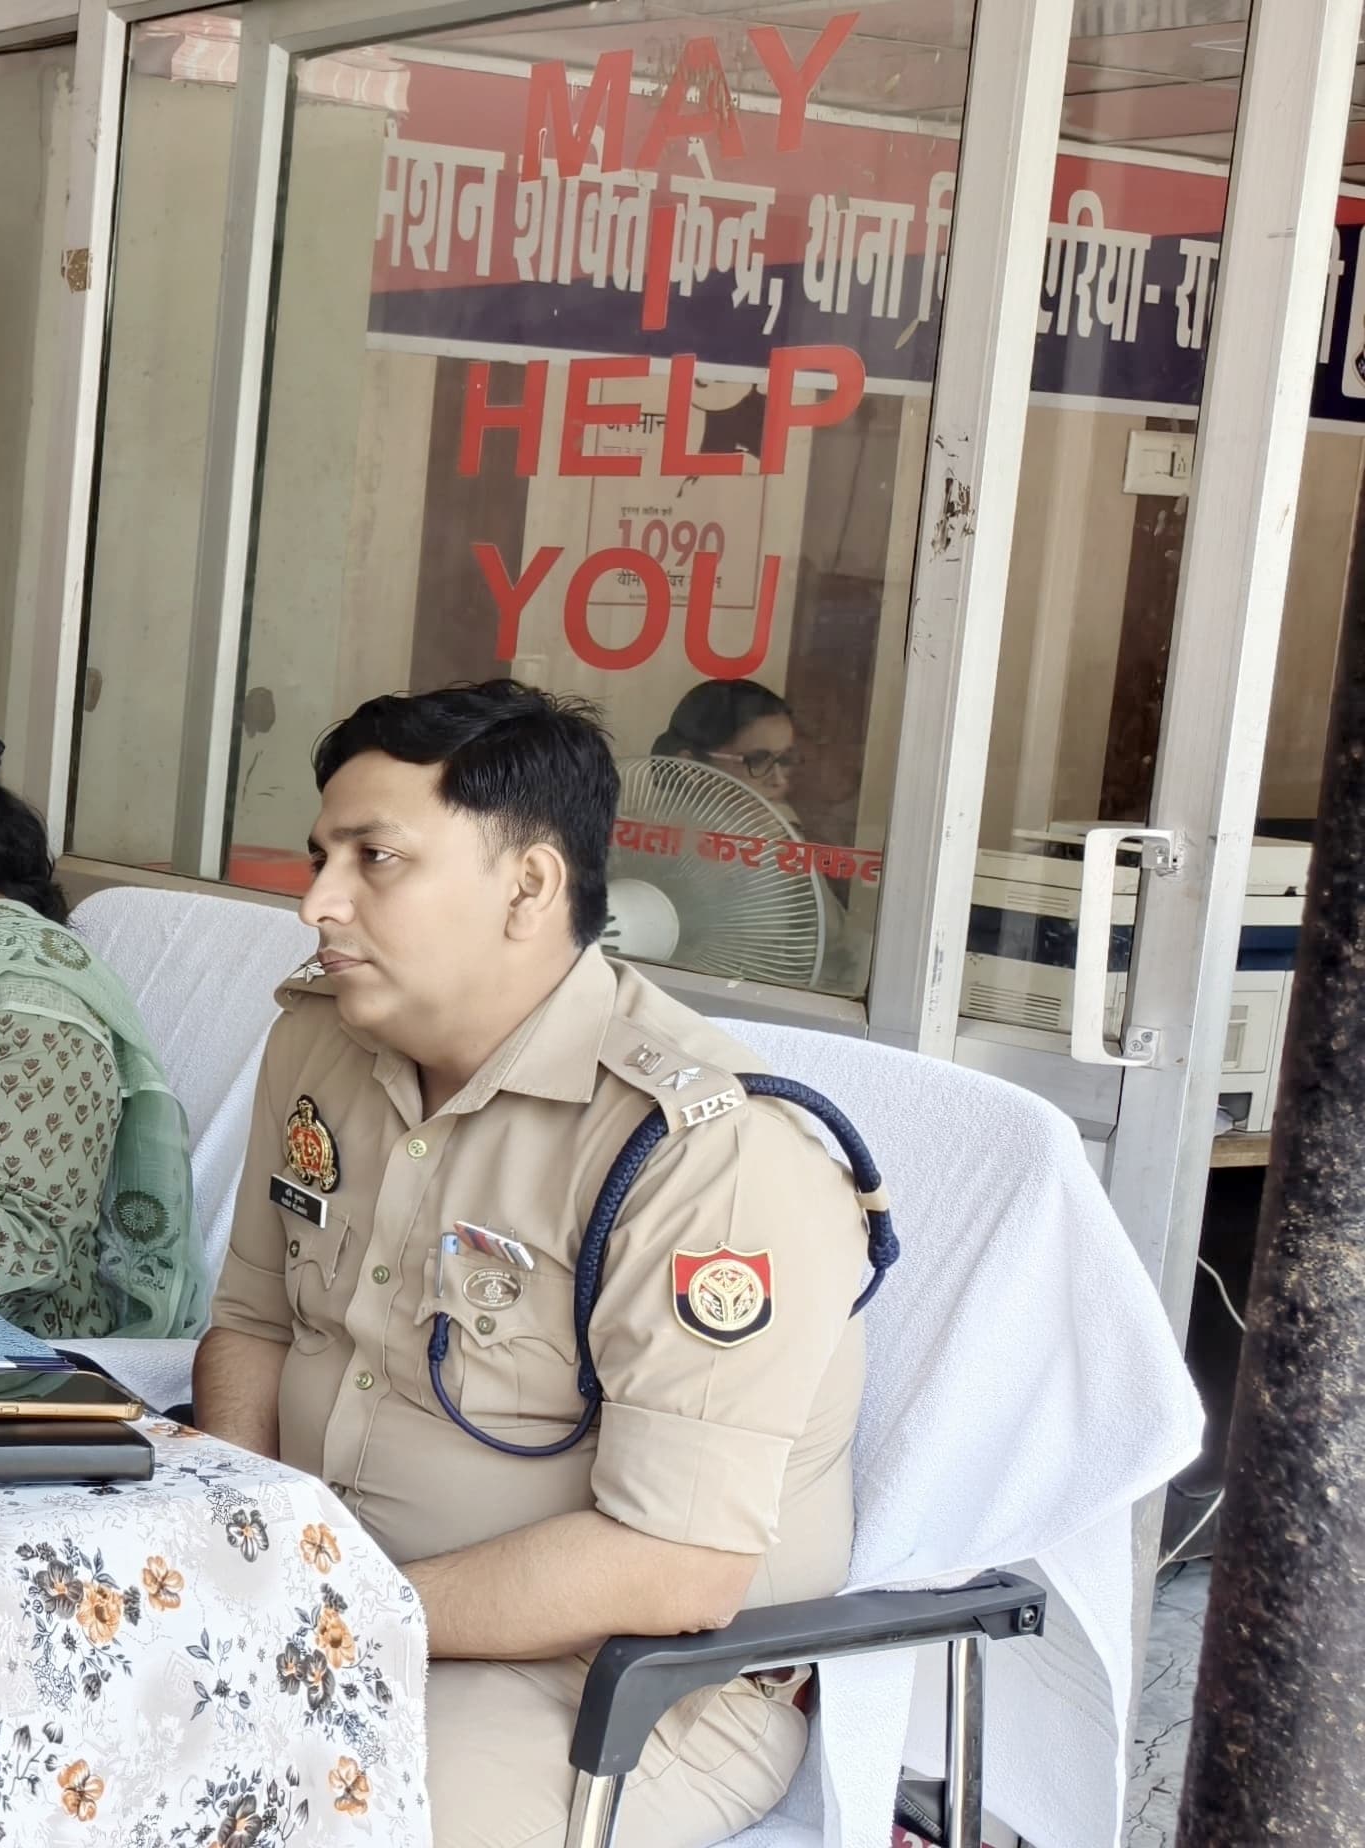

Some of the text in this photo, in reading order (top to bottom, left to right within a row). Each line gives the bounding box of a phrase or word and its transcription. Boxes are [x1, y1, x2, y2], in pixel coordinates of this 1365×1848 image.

[520, 12, 860, 182] MAY
[642, 205, 677, 331] I
[803, 194, 914, 318] थाना
[457, 345, 866, 476] HELP
[618, 519, 726, 567] 1090
[472, 543, 782, 681] YOU
[695, 830, 768, 868] कर
[680, 1088, 743, 1127] IPS
